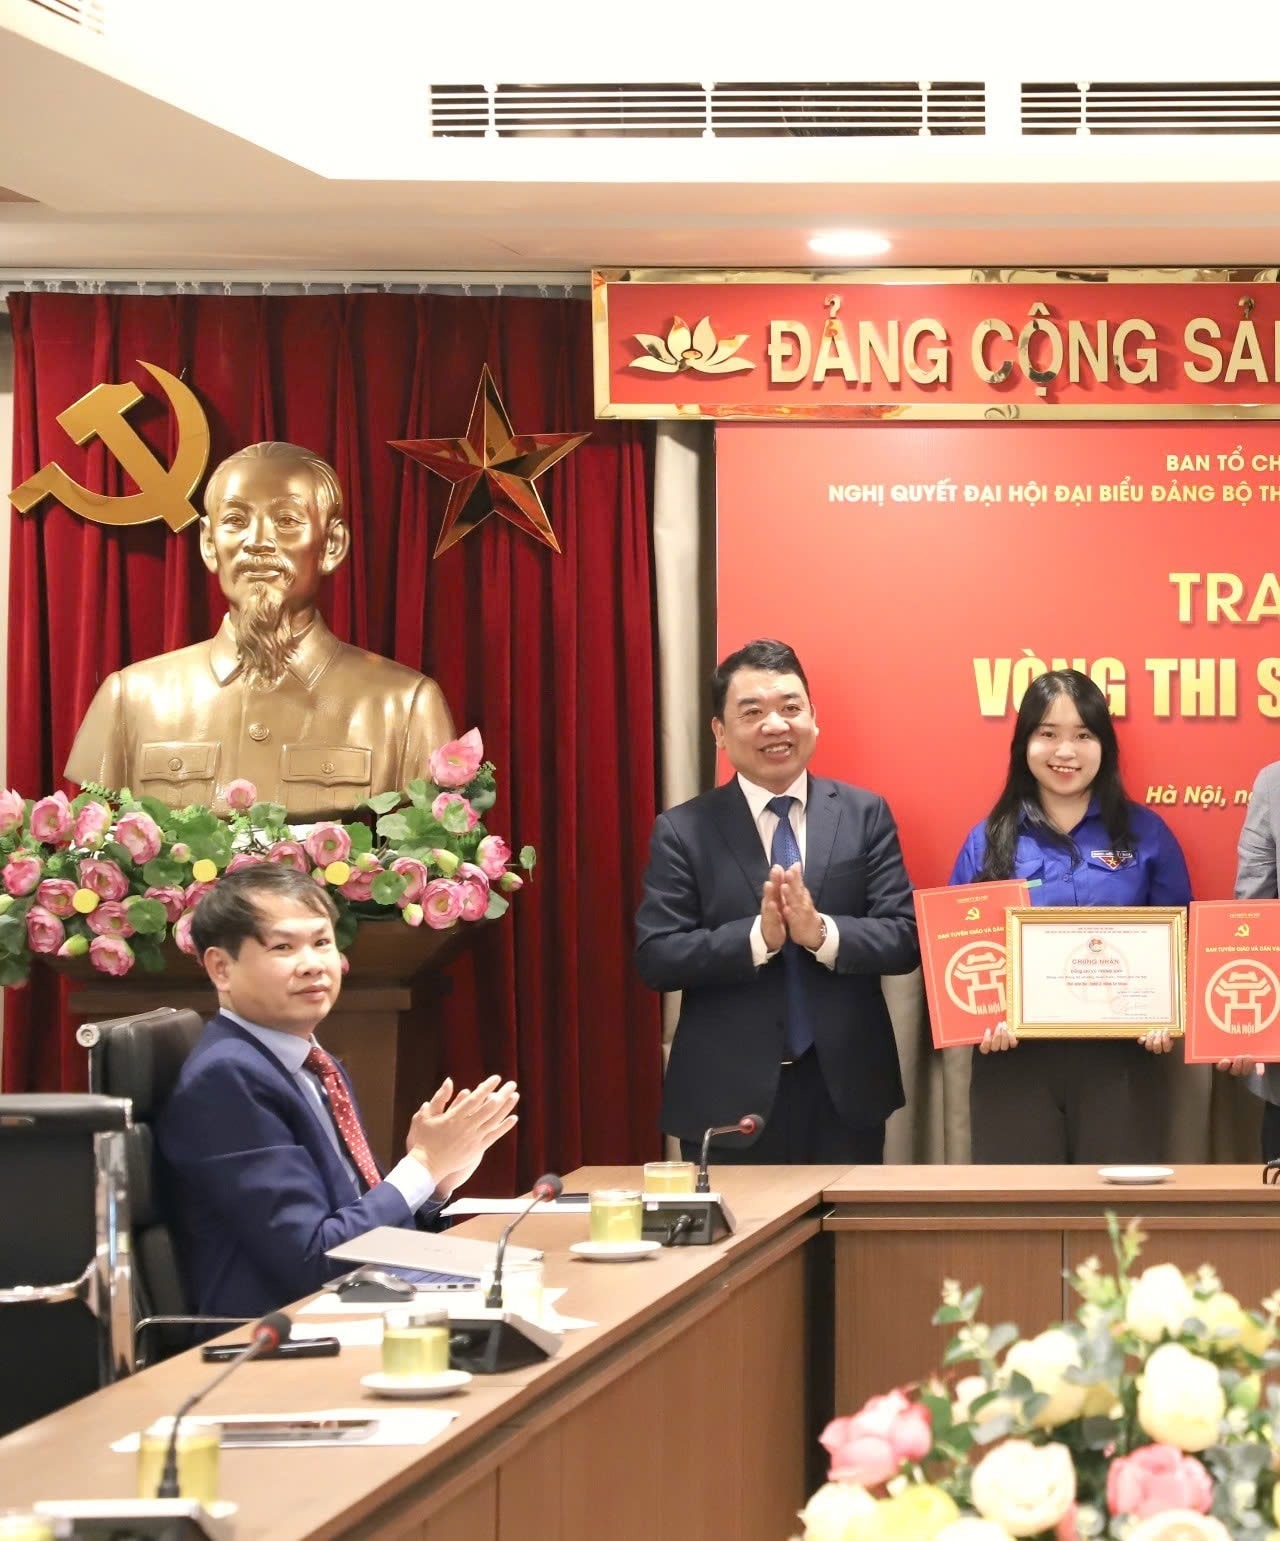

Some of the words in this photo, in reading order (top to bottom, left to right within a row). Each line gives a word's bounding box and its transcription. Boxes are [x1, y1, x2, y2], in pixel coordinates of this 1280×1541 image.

[767, 295, 951, 384] ĐẢNG
[971, 301, 1159, 397] CỘNG
[1166, 454, 1210, 472] BAN
[1216, 445, 1245, 472] TỔ
[829, 485, 884, 507] NGHỊ
[890, 478, 958, 504] QUYẾT
[963, 485, 1002, 507] ĐẠI
[1008, 480, 1048, 507] HỘI
[1054, 485, 1092, 507] ĐẠI
[1099, 476, 1145, 502] BIỂU
[1150, 478, 1216, 502] ĐẢNG
[1222, 480, 1252, 506] BỘ
[1145, 658, 1237, 717] THI
[1145, 784, 1178, 804] Hà
[1183, 784, 1227, 808] Nội,
